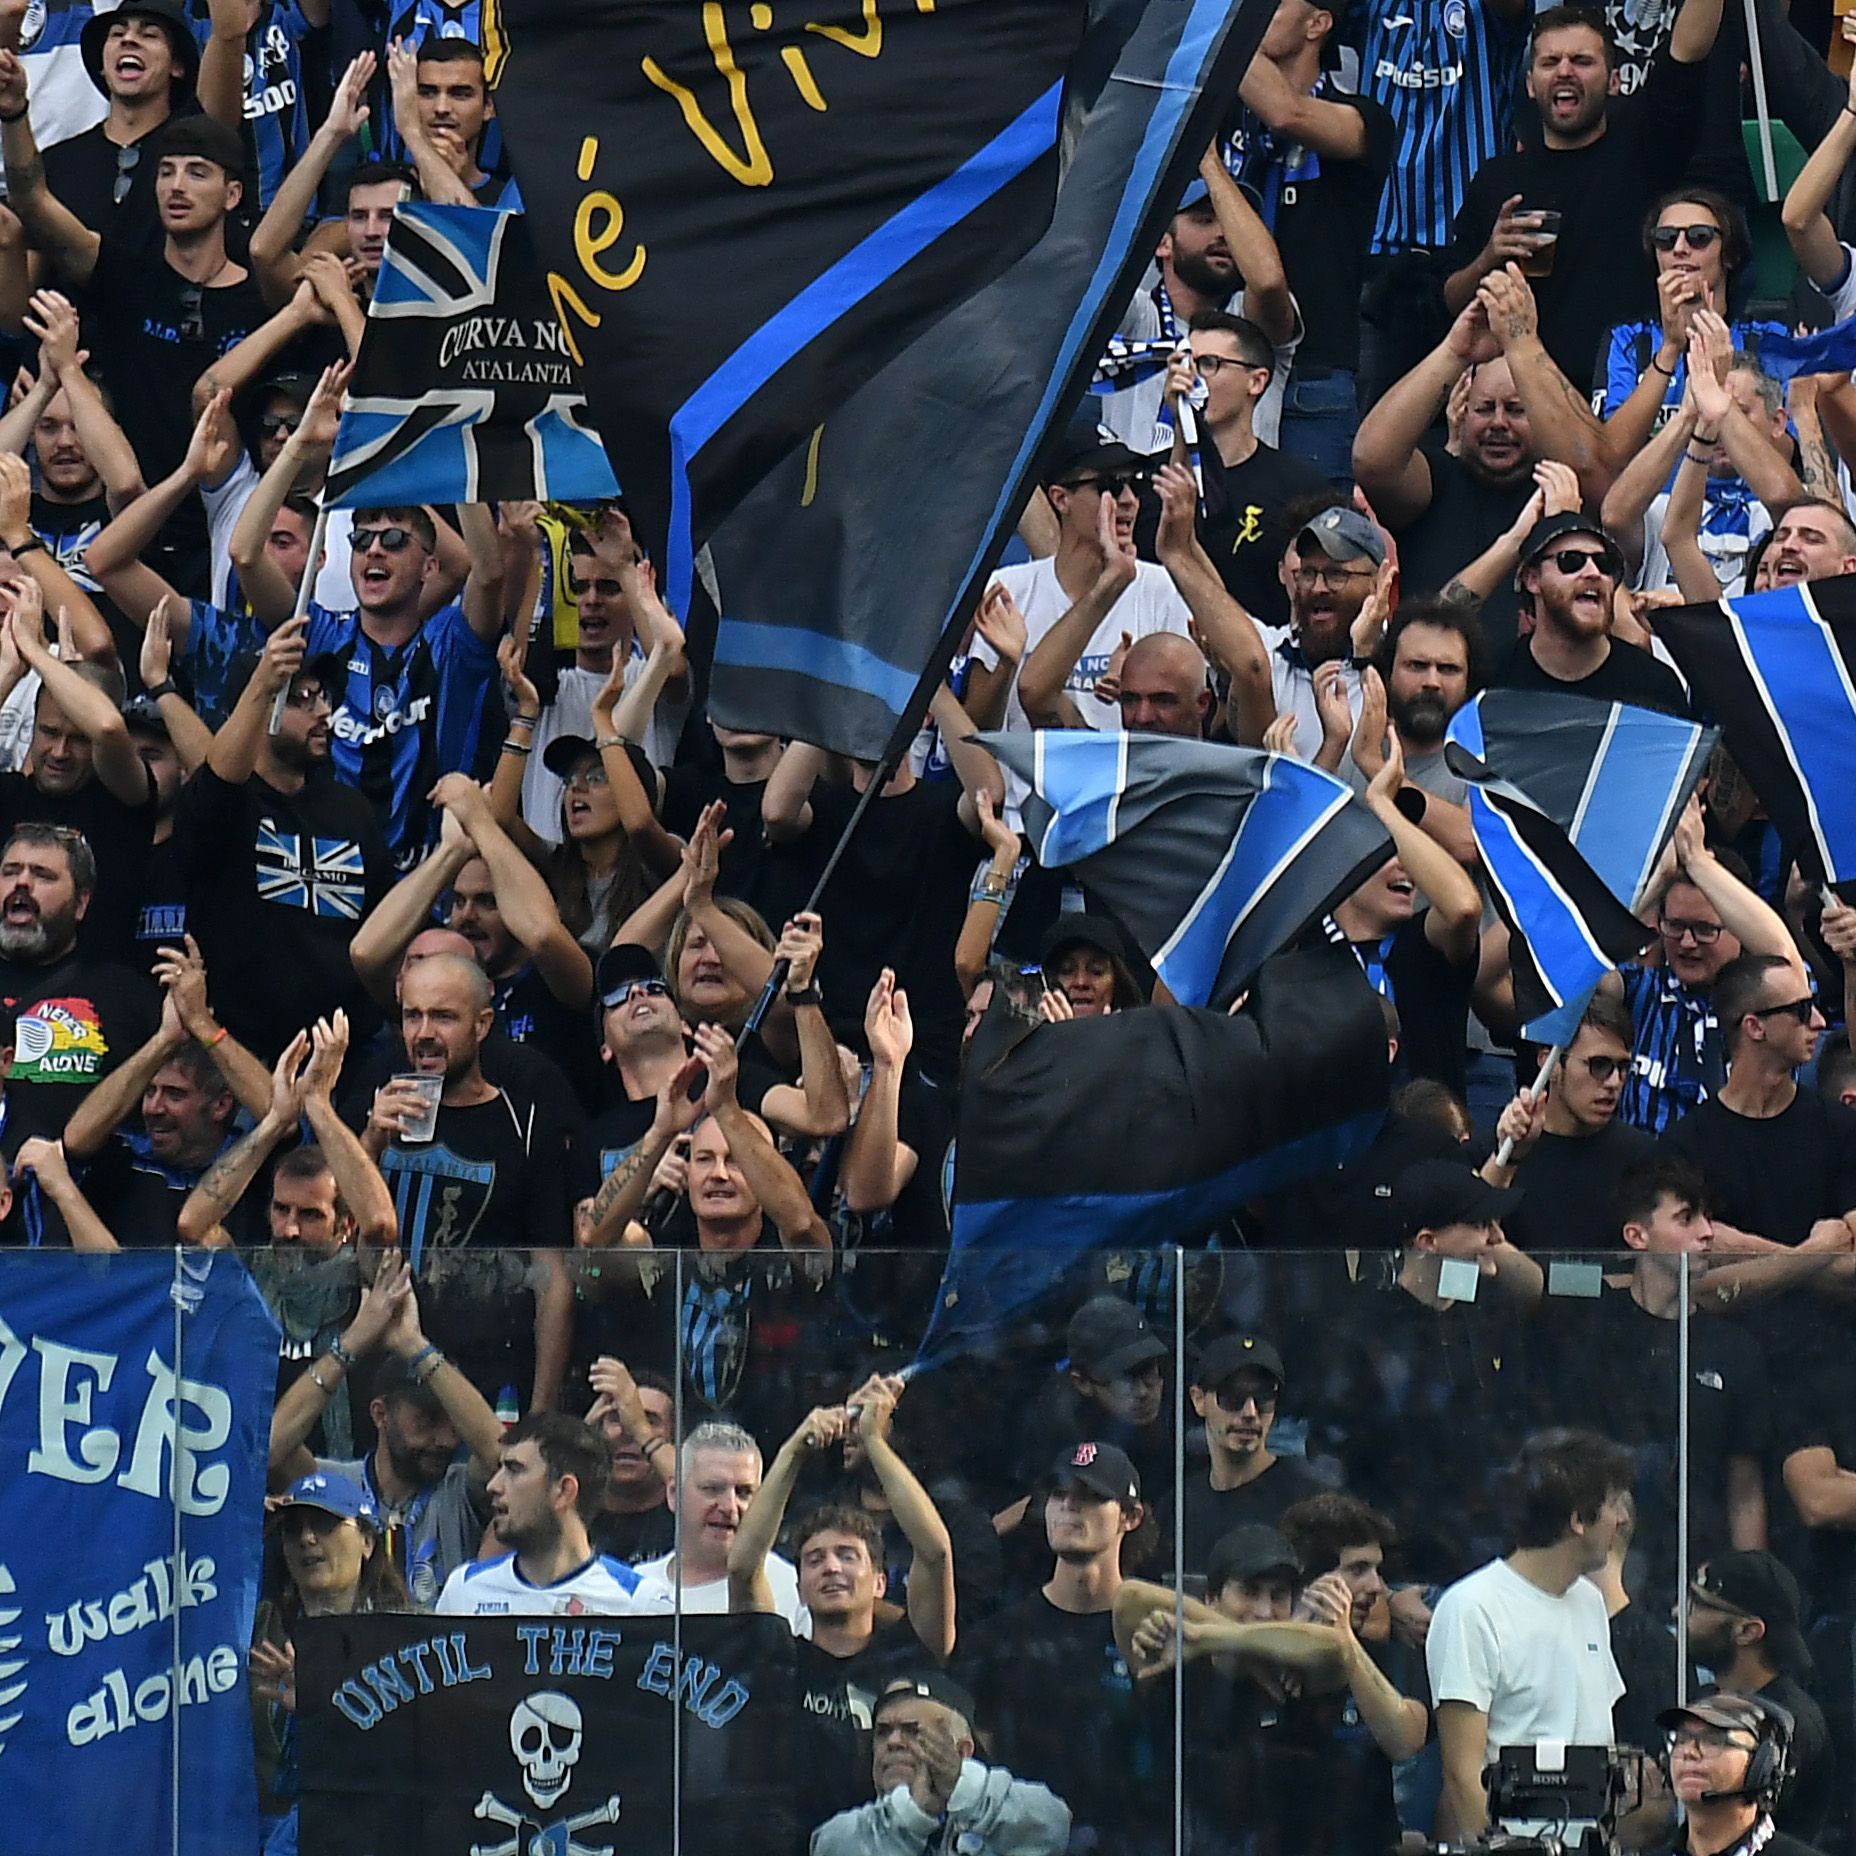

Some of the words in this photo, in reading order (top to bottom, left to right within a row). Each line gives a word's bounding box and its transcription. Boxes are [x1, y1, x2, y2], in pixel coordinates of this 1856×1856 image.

[438, 317, 524, 370] CURVA
[533, 319, 571, 358] NO
[462, 360, 573, 387] ATALANTA
[45, 1545, 219, 1657] walk
[65, 1643, 240, 1747] alone
[330, 1630, 494, 1732] UNTIL
[516, 1625, 624, 1679] THE
[639, 1640, 752, 1732] END
